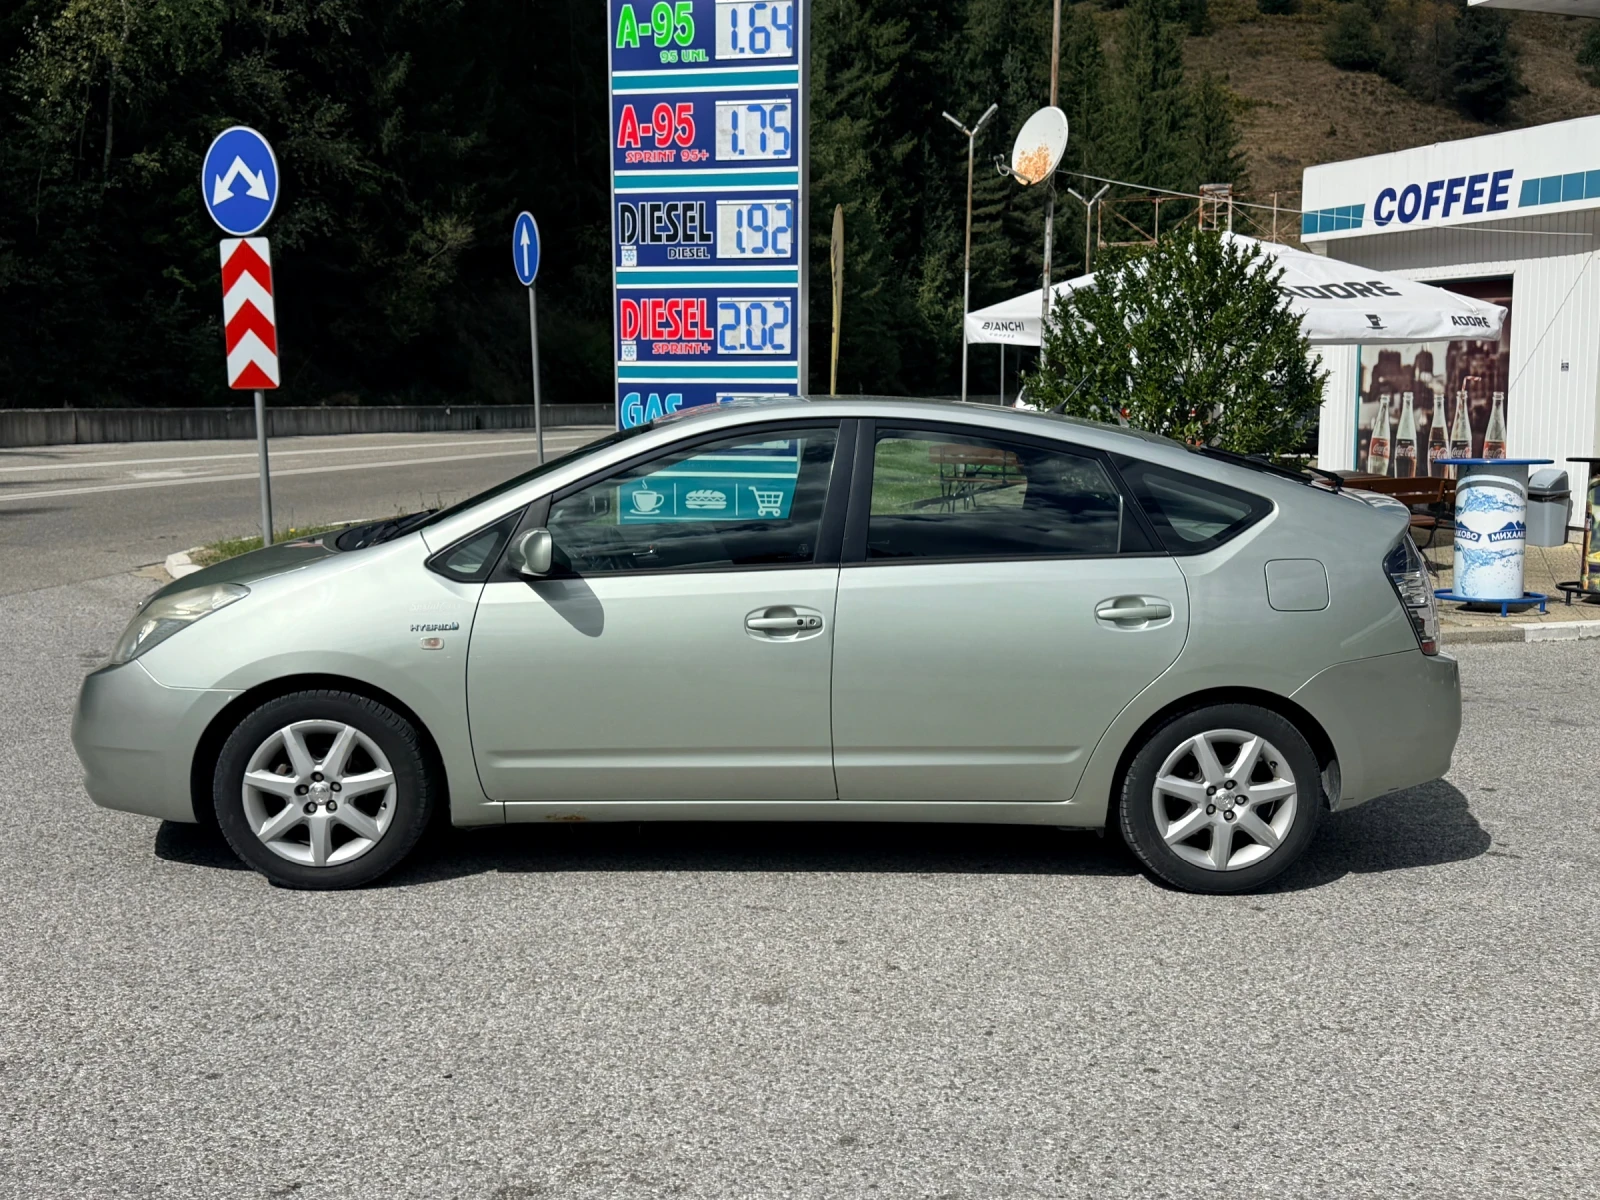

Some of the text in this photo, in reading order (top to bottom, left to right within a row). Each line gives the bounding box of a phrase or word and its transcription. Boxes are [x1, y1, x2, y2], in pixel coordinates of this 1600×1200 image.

[616, 1, 695, 48] A-95
[730, 3, 792, 54] 1.64
[659, 49, 710, 63] 95 UNL
[617, 102, 696, 148] A-95
[731, 104, 790, 156] 1.75
[625, 149, 710, 164] SPRINT 95+
[1373, 169, 1515, 227] COFFEE
[618, 201, 714, 245] DIESEL
[667, 247, 711, 260] DIESEL
[620, 298, 714, 341] DIESEL
[718, 301, 790, 351] 2.02
[981, 321, 1025, 332] BIANCHI
[1450, 315, 1491, 328] ADORE
[652, 343, 712, 355] SPRINT+
